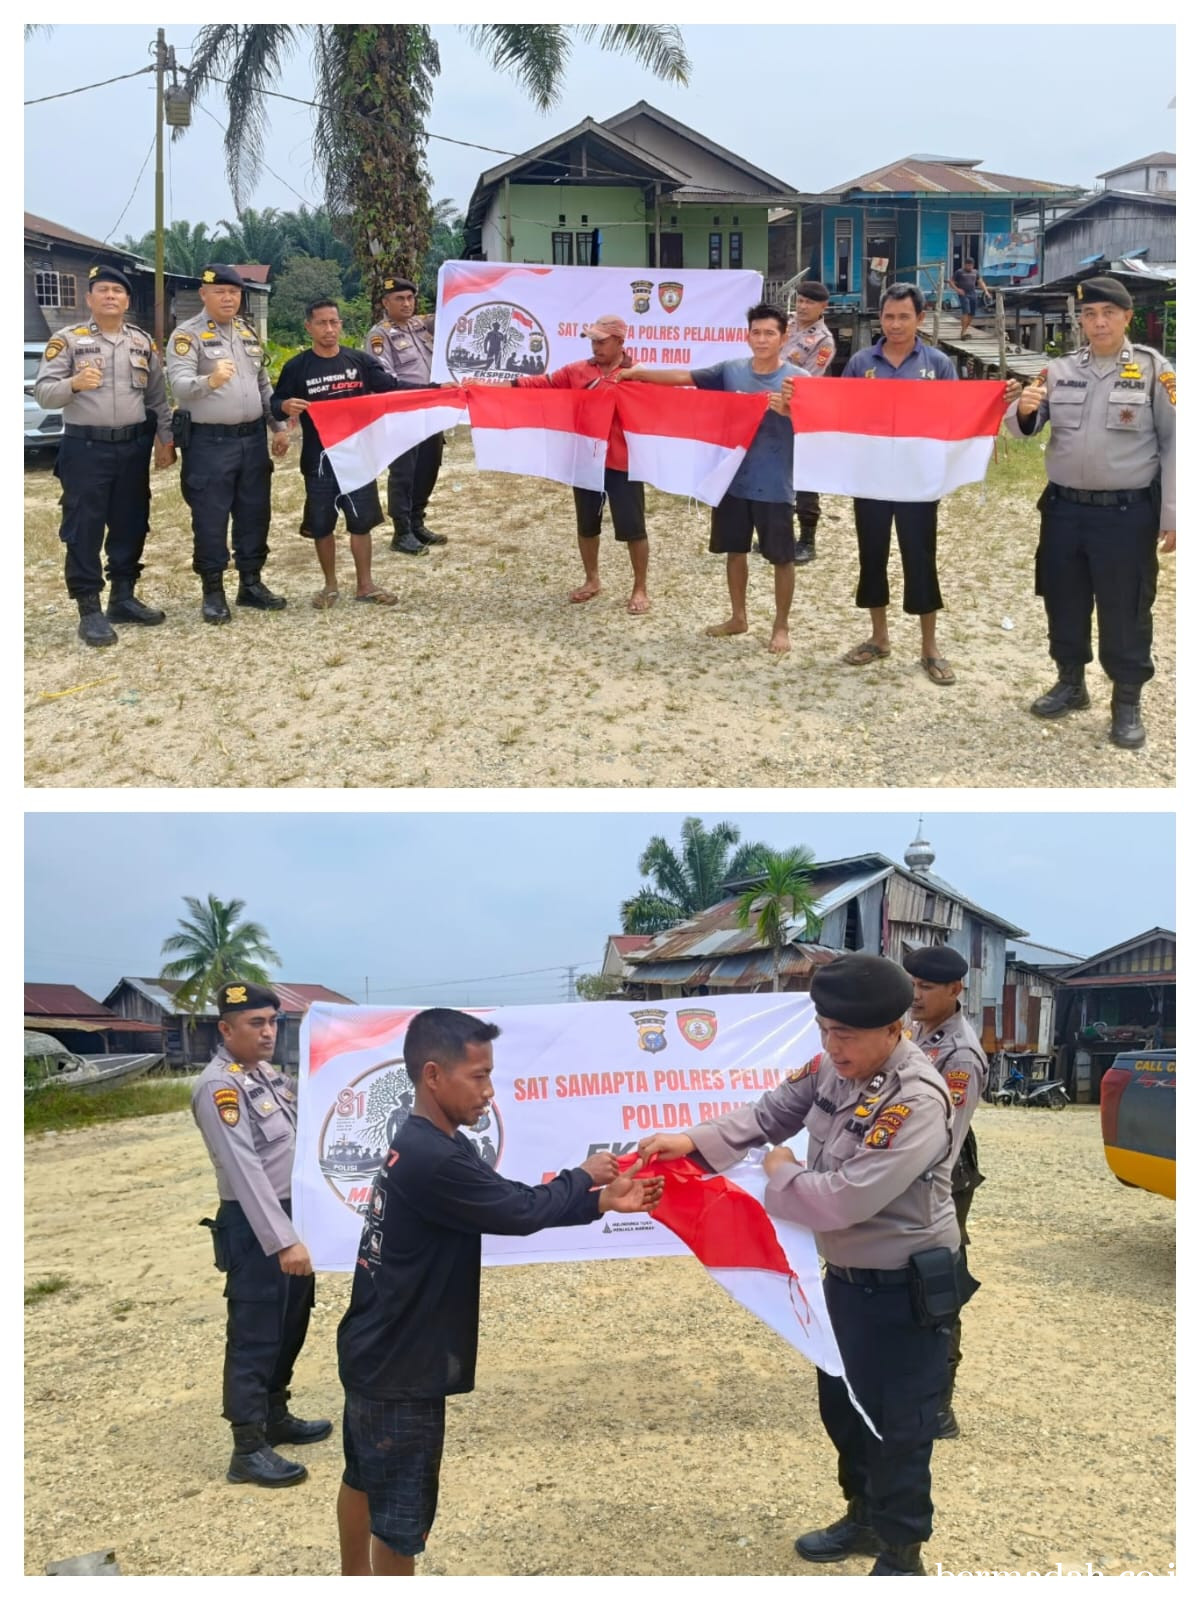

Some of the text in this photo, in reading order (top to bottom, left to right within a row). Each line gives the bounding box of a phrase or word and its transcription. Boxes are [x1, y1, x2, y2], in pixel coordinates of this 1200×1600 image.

[558, 322, 577, 337] SAT
[639, 327, 680, 341] POLRES
[622, 347, 691, 364] OLDA RIAU
[306, 374, 345, 386] BELI MESIN
[919, 369, 935, 380] 14
[1114, 380, 1145, 389] POLRI
[1135, 1060, 1163, 1072] CALL
[513, 1076, 549, 1101] SAT
[556, 1070, 648, 1098] SAMAPTA
[655, 1068, 724, 1092] POLRES
[337, 1088, 365, 1119] 81
[622, 1101, 746, 1130] POLDA RIA
[333, 1164, 358, 1172] POLISI
